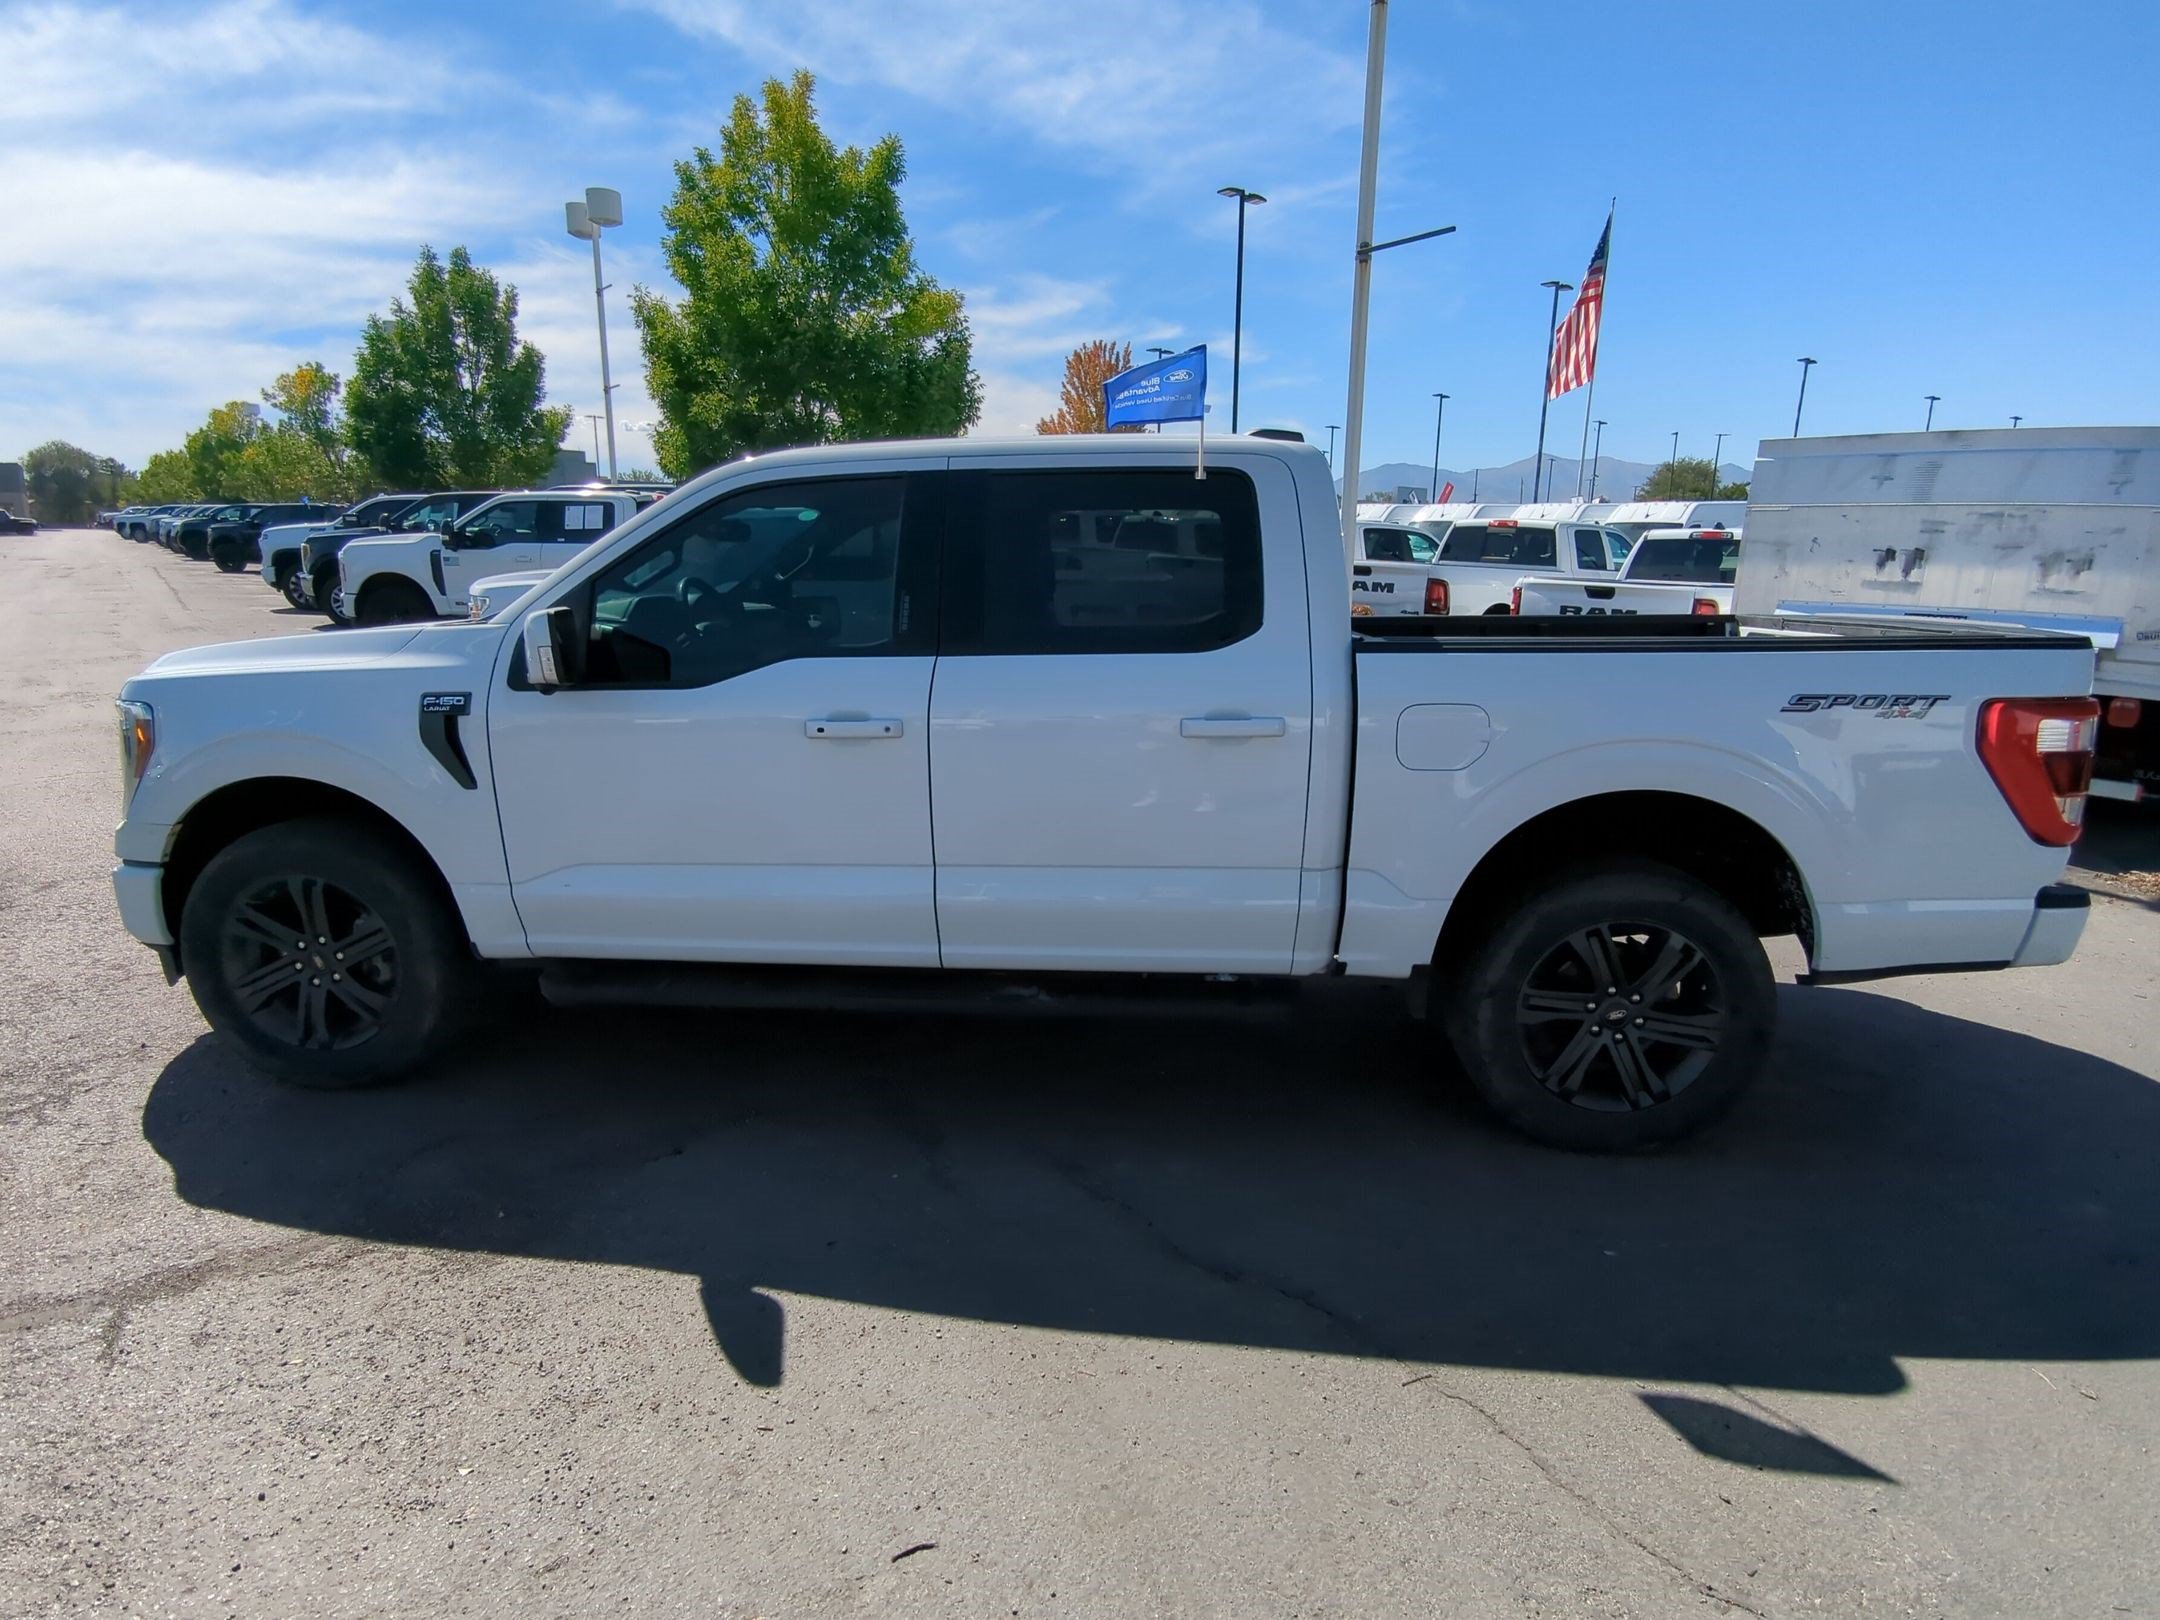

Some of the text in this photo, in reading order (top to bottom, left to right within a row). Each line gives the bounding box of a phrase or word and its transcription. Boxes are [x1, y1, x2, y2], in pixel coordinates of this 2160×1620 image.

[1352, 581, 1395, 594] AM
[1559, 605, 1638, 616] RAM
[1780, 693, 1952, 713] SPORT
